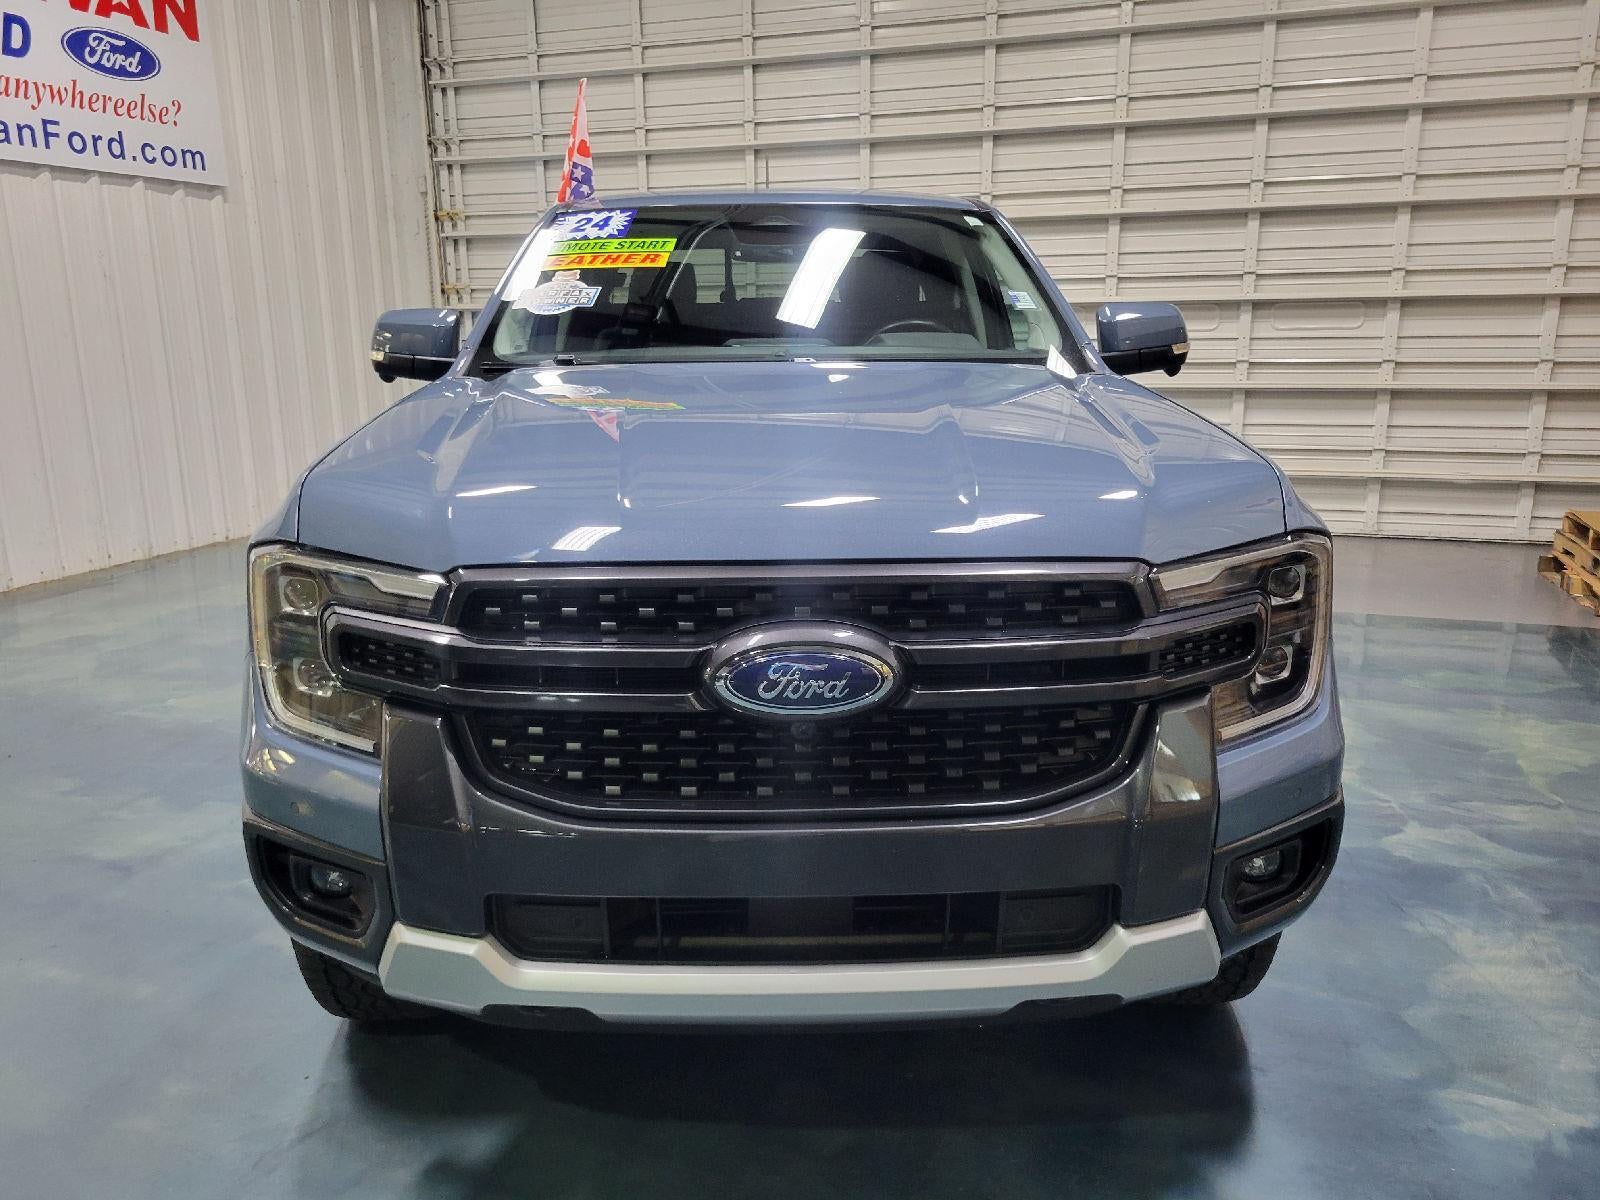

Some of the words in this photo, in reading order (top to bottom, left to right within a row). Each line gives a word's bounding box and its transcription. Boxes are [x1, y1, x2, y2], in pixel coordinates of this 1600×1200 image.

[84, 33, 141, 73] Ford
[0, 74, 182, 127] anywhereelse?
[0, 118, 206, 171] anFord.com
[570, 216, 613, 233] 24
[552, 253, 661, 267] EATHER
[614, 240, 670, 251] START
[757, 662, 852, 700] Ford
